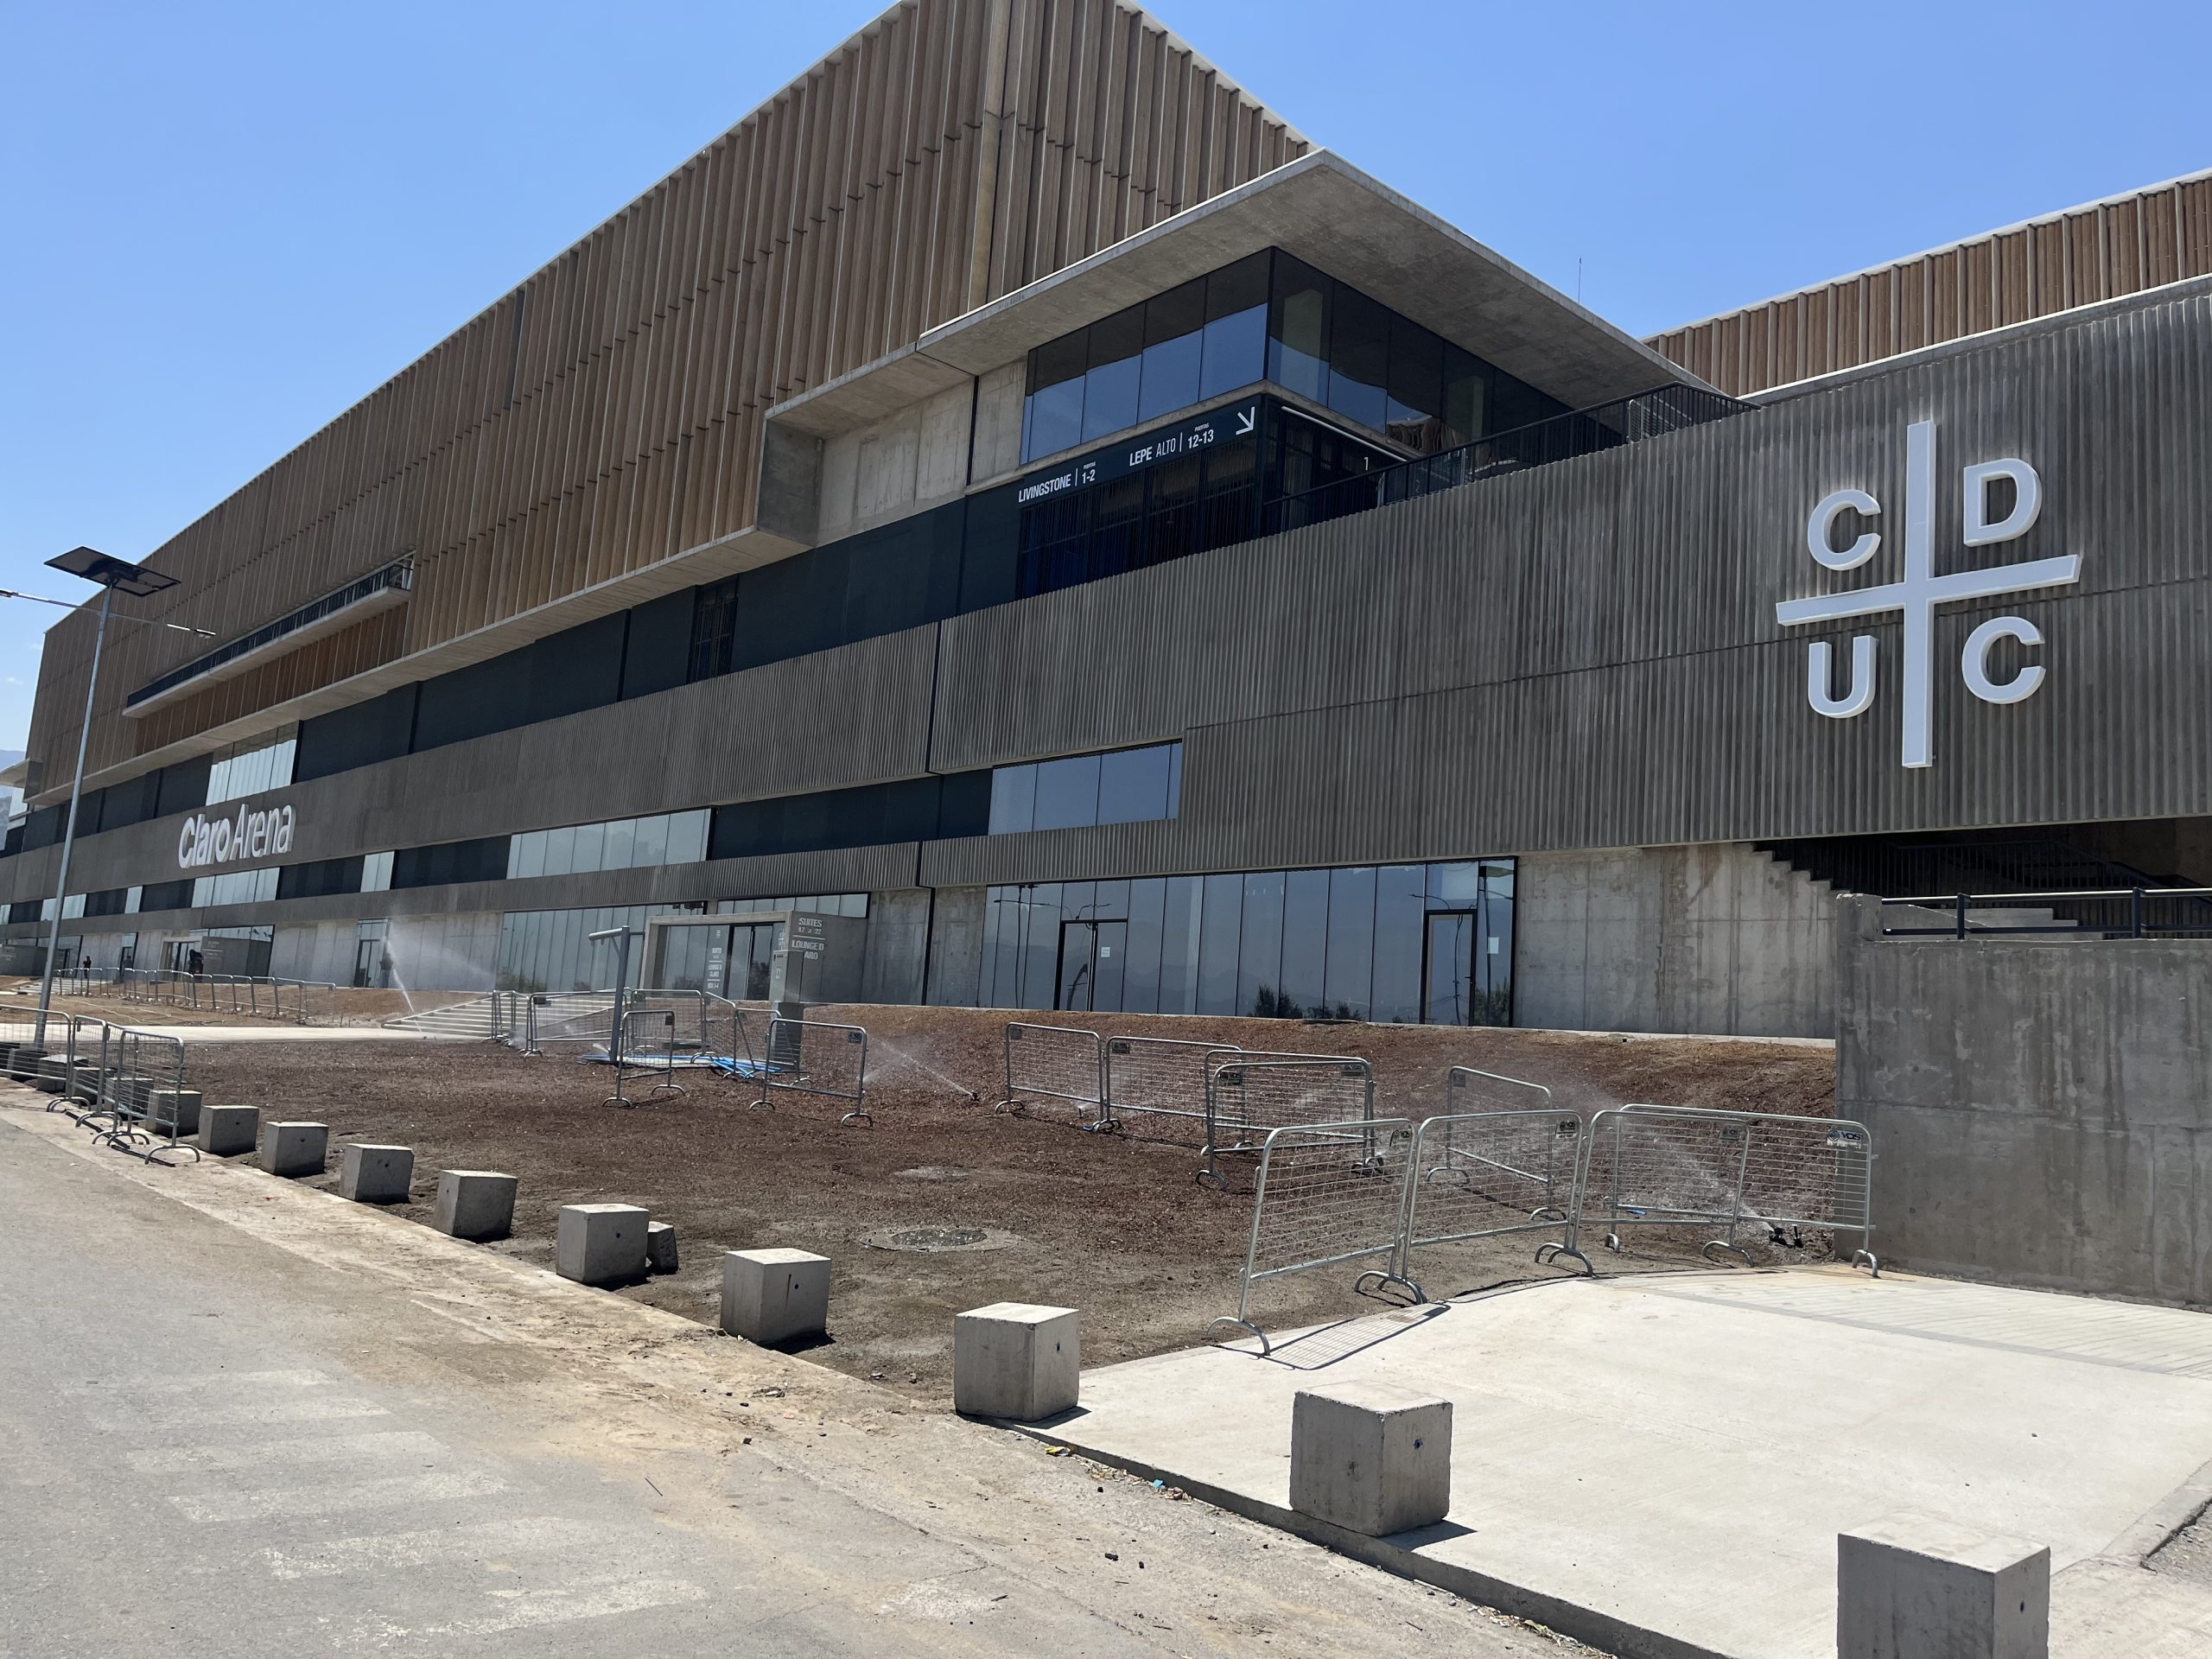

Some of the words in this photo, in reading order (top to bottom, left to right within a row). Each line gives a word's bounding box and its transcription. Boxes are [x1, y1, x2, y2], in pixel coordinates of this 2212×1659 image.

[1129, 446, 1153, 467] LEPE
[1156, 437, 1176, 458] ALTO
[1187, 429, 1214, 449] 12-13
[1363, 456, 1369, 471] 1
[1019, 473, 1071, 503] LIVINGSTONE
[1082, 469, 1096, 484] 1-2
[178, 813, 232, 869] Claro
[229, 803, 296, 861] Arena
[798, 917, 823, 927] SUITES
[791, 939, 818, 950] LOUNGE
[804, 950, 818, 960] ARO
